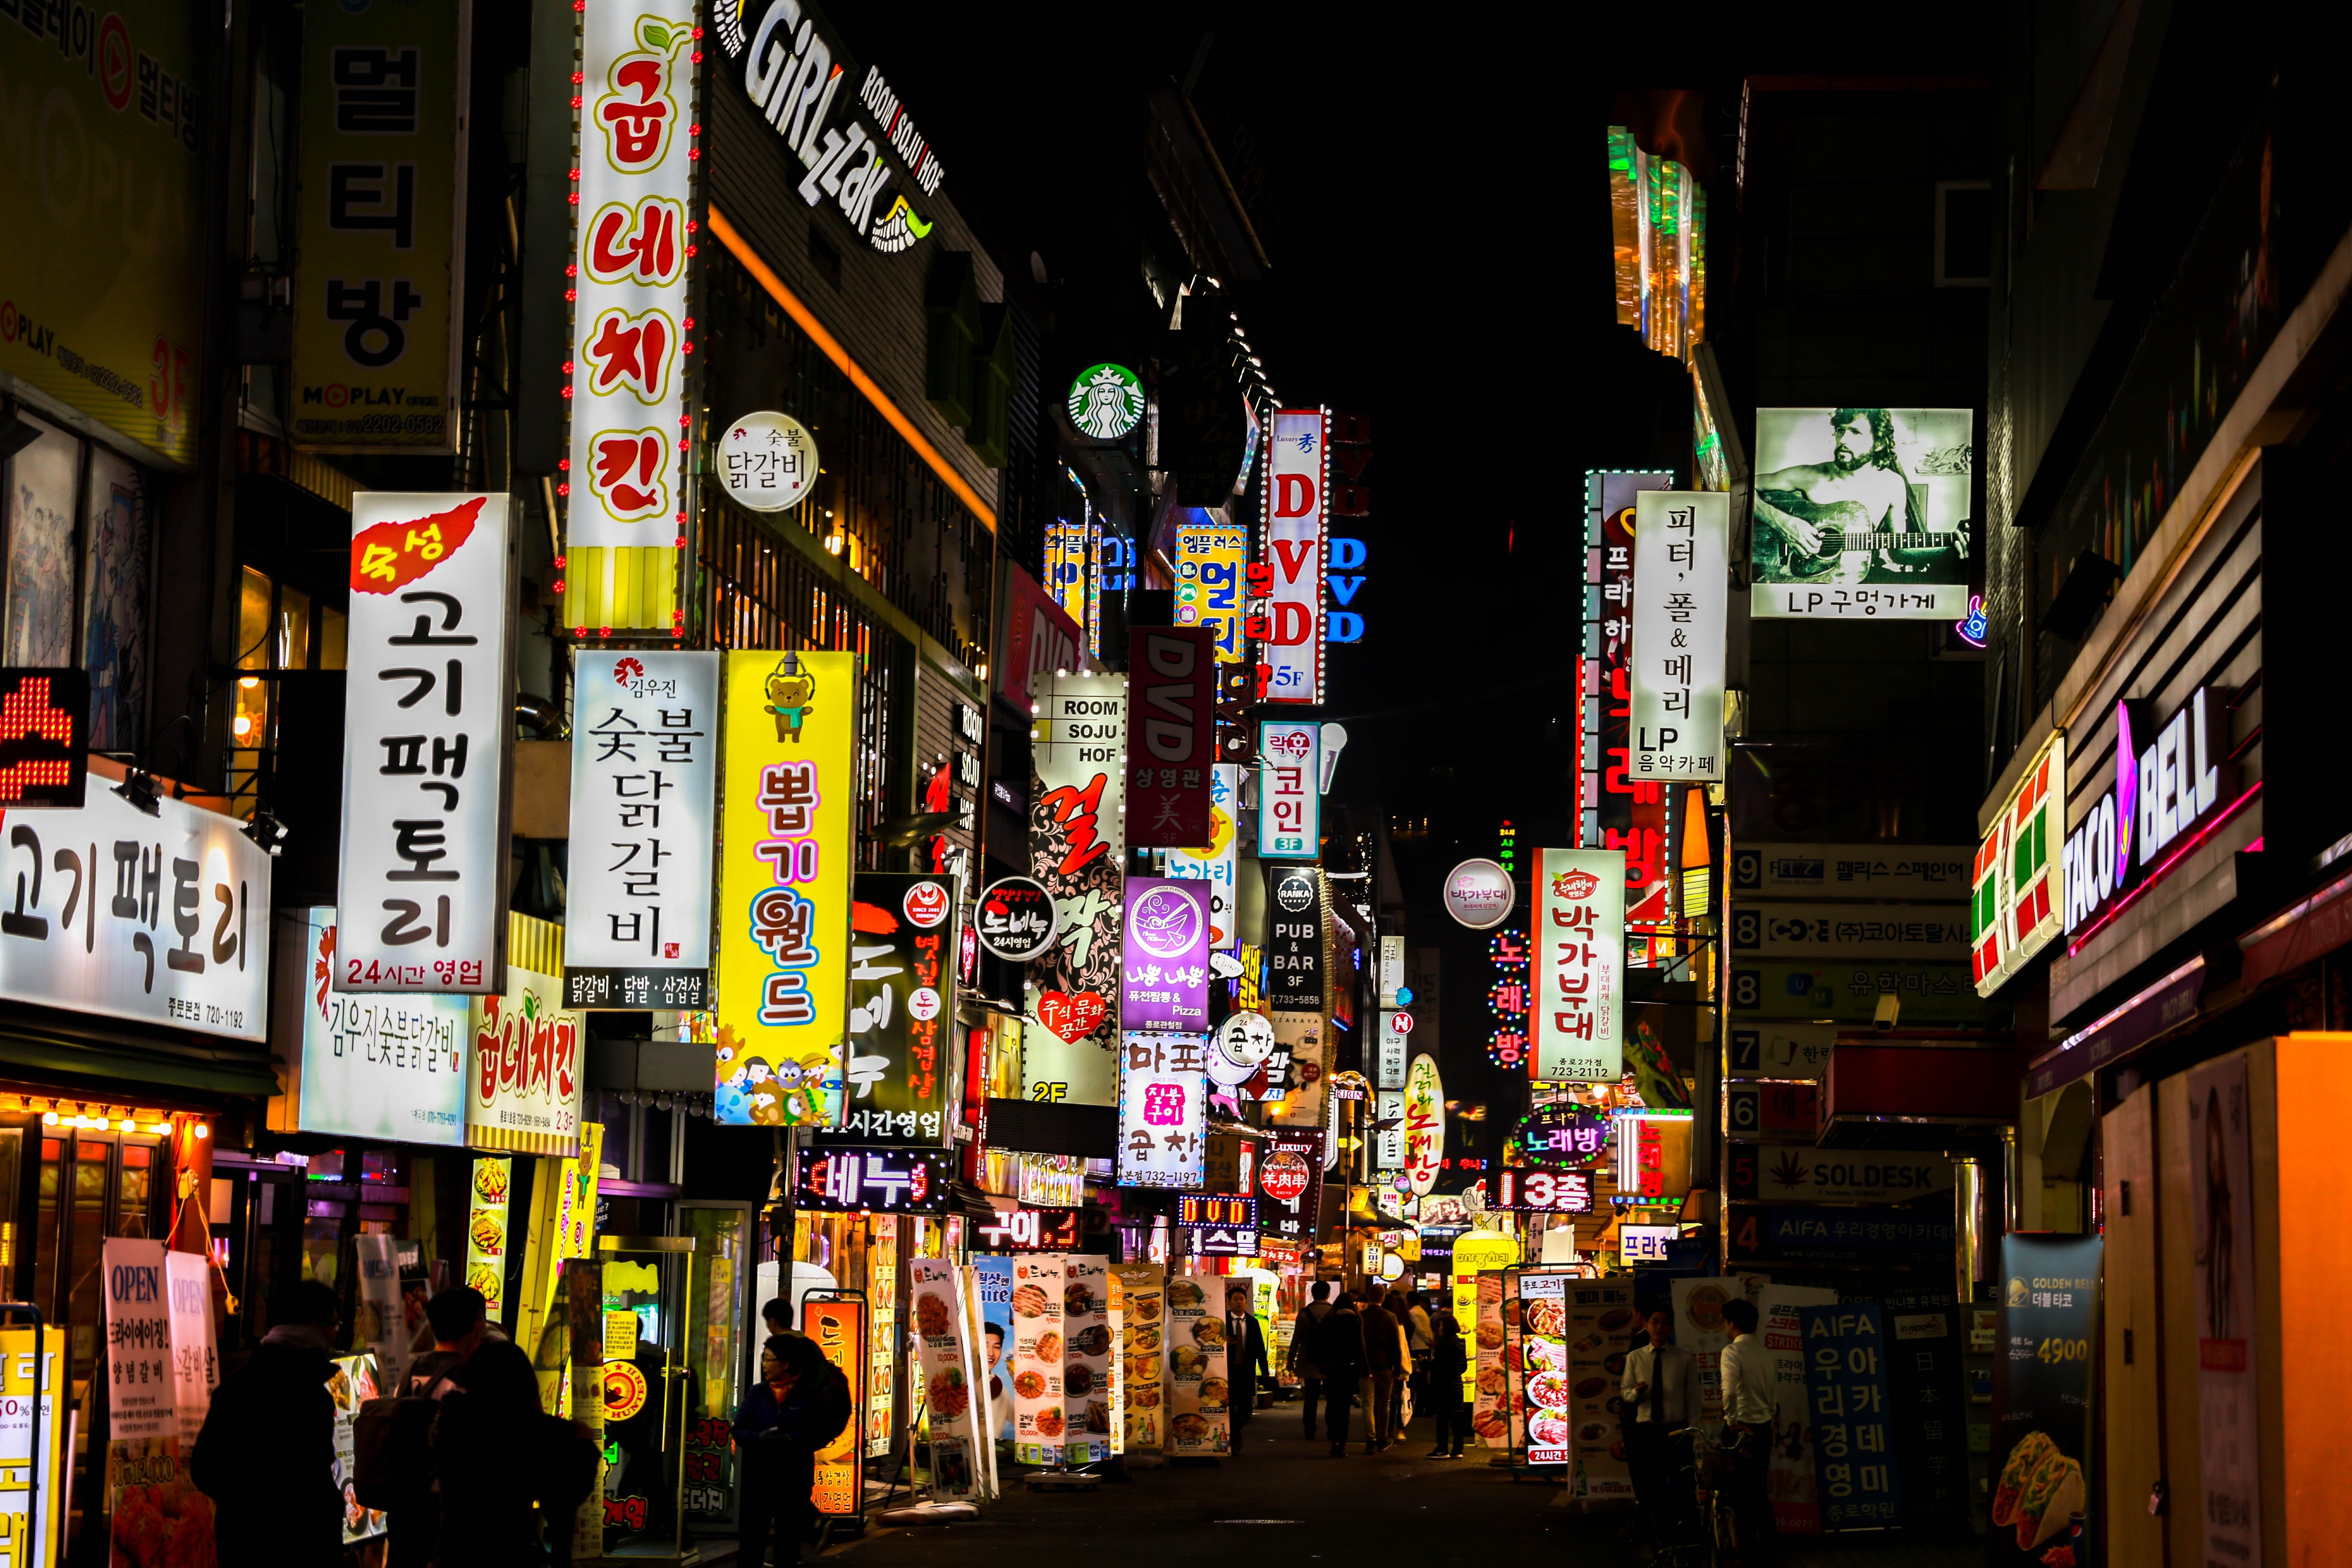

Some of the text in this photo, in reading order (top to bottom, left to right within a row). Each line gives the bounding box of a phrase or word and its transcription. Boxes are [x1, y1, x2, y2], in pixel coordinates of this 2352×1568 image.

[861, 64, 946, 197] ROOM SOJU HOF
[326, 47, 424, 369] 멀티방
[593, 60, 675, 511] 굽네치킨
[766, 429, 803, 447] 숯불
[726, 450, 805, 489] 닭갈비
[359, 524, 444, 582] 숙성
[1182, 535, 1242, 554] 엠플러스
[1270, 474, 1316, 646] DVD
[1326, 538, 1369, 643] DVD
[1788, 589, 1935, 615] LP 구멍가게
[628, 678, 677, 700] 김우진
[1275, 666, 1304, 687] 5F
[1064, 701, 1118, 715] ROOM
[1144, 633, 1195, 764] DVD
[588, 707, 705, 763] 숯불
[1069, 724, 1117, 739] SOJU
[1638, 726, 1679, 752] LP
[1079, 748, 1116, 762] HOF
[1638, 754, 1715, 774] 음악카페
[377, 590, 479, 948] 고기팩토리
[1136, 768, 1202, 789] 상영관
[1152, 793, 1184, 832] 美
[1274, 767, 1304, 833] 코인
[2062, 686, 2218, 937] TACO BELL
[1161, 832, 1177, 844] 3F
[1278, 839, 1299, 850] 3F
[607, 769, 674, 957] 닭갈비
[1736, 855, 1963, 884] 9 펠리스 스페인어
[750, 761, 821, 1025] 뽑기월드
[1281, 889, 1310, 897] RANKA
[1450, 888, 1507, 901] 박가부대
[1558, 879, 1592, 894] 수제햄이
[1568, 890, 1585, 898] 맛있는
[993, 936, 1031, 948] 24시영업
[1275, 924, 1314, 939] PUB
[1736, 916, 1758, 944] 8
[1290, 942, 1298, 952] &
[347, 959, 482, 985] 24시간 영업
[1274, 955, 1314, 971] BAR
[1551, 905, 1599, 1042] 박가부대
[1126, 965, 1205, 988] 니뽕 내뽕
[1287, 976, 1304, 986] 3F
[572, 975, 701, 1004] 닭갈비 닭발 삼겹살
[1128, 990, 1181, 1003] 퓨전짬뽕 &
[1269, 995, 1320, 1005] T.733-5858
[1495, 937, 1525, 1063] 노래방
[1736, 976, 1758, 1004] 8
[168, 997, 243, 1029] 종로본점 720-1192
[1042, 998, 1104, 1026] 주식 문화
[1172, 1004, 1202, 1017] Pizza
[1059, 1019, 1090, 1038] 공간
[1145, 1020, 1182, 1029] 종로관철점
[1305, 1028, 1318, 1037] 2F
[476, 994, 577, 1099] 굽네치킨
[1228, 1027, 1271, 1053] 곱창
[1736, 1036, 1755, 1064] 7
[1129, 1044, 1204, 1073] 마포
[1559, 1057, 1602, 1067] 종로2가점
[1415, 1063, 1436, 1106] 질러봐
[1551, 1066, 1609, 1078] 723-2112
[1032, 1081, 1067, 1102] 2F
[1148, 1087, 1182, 1105] 짚불
[1335, 1088, 1363, 1100] KIRIN
[1146, 1107, 1182, 1124] 구이
[1540, 1112, 1579, 1125] 프라하
[1733, 1097, 1755, 1126] 6
[1128, 1130, 1198, 1162] 곱창
[1271, 1140, 1313, 1154] Luxury
[1405, 1102, 1439, 1182] 노래방
[1527, 1127, 1599, 1153] 노래방
[1638, 1119, 1665, 1197] 노래방
[1124, 1170, 1197, 1182] 본점 732-1197
[1262, 1172, 1307, 1188] 羊肉串
[1732, 1156, 1932, 1189] 5 SOLDESK
[1524, 1173, 1589, 1210] 3층
[1183, 1199, 1243, 1224] DVD
[1736, 1215, 1829, 1253] 4 AIFA
[112, 1265, 158, 1301] OPEN
[173, 1277, 207, 1314] OPEN
[1522, 1279, 1537, 1290] 종로
[2032, 1277, 2095, 1289] GOLDEN BELL
[1920, 1294, 1952, 1308] 유학원
[2032, 1292, 2073, 1308] 더블타코
[1809, 1314, 1877, 1339] AIFA
[2010, 1336, 2034, 1346] 세트 Set
[2036, 1337, 2089, 1364] 4900
[1815, 1347, 1853, 1498] 우리경영
[1848, 1346, 1890, 1494] 아카데미
[1825, 1503, 1896, 1522] 종로학원
